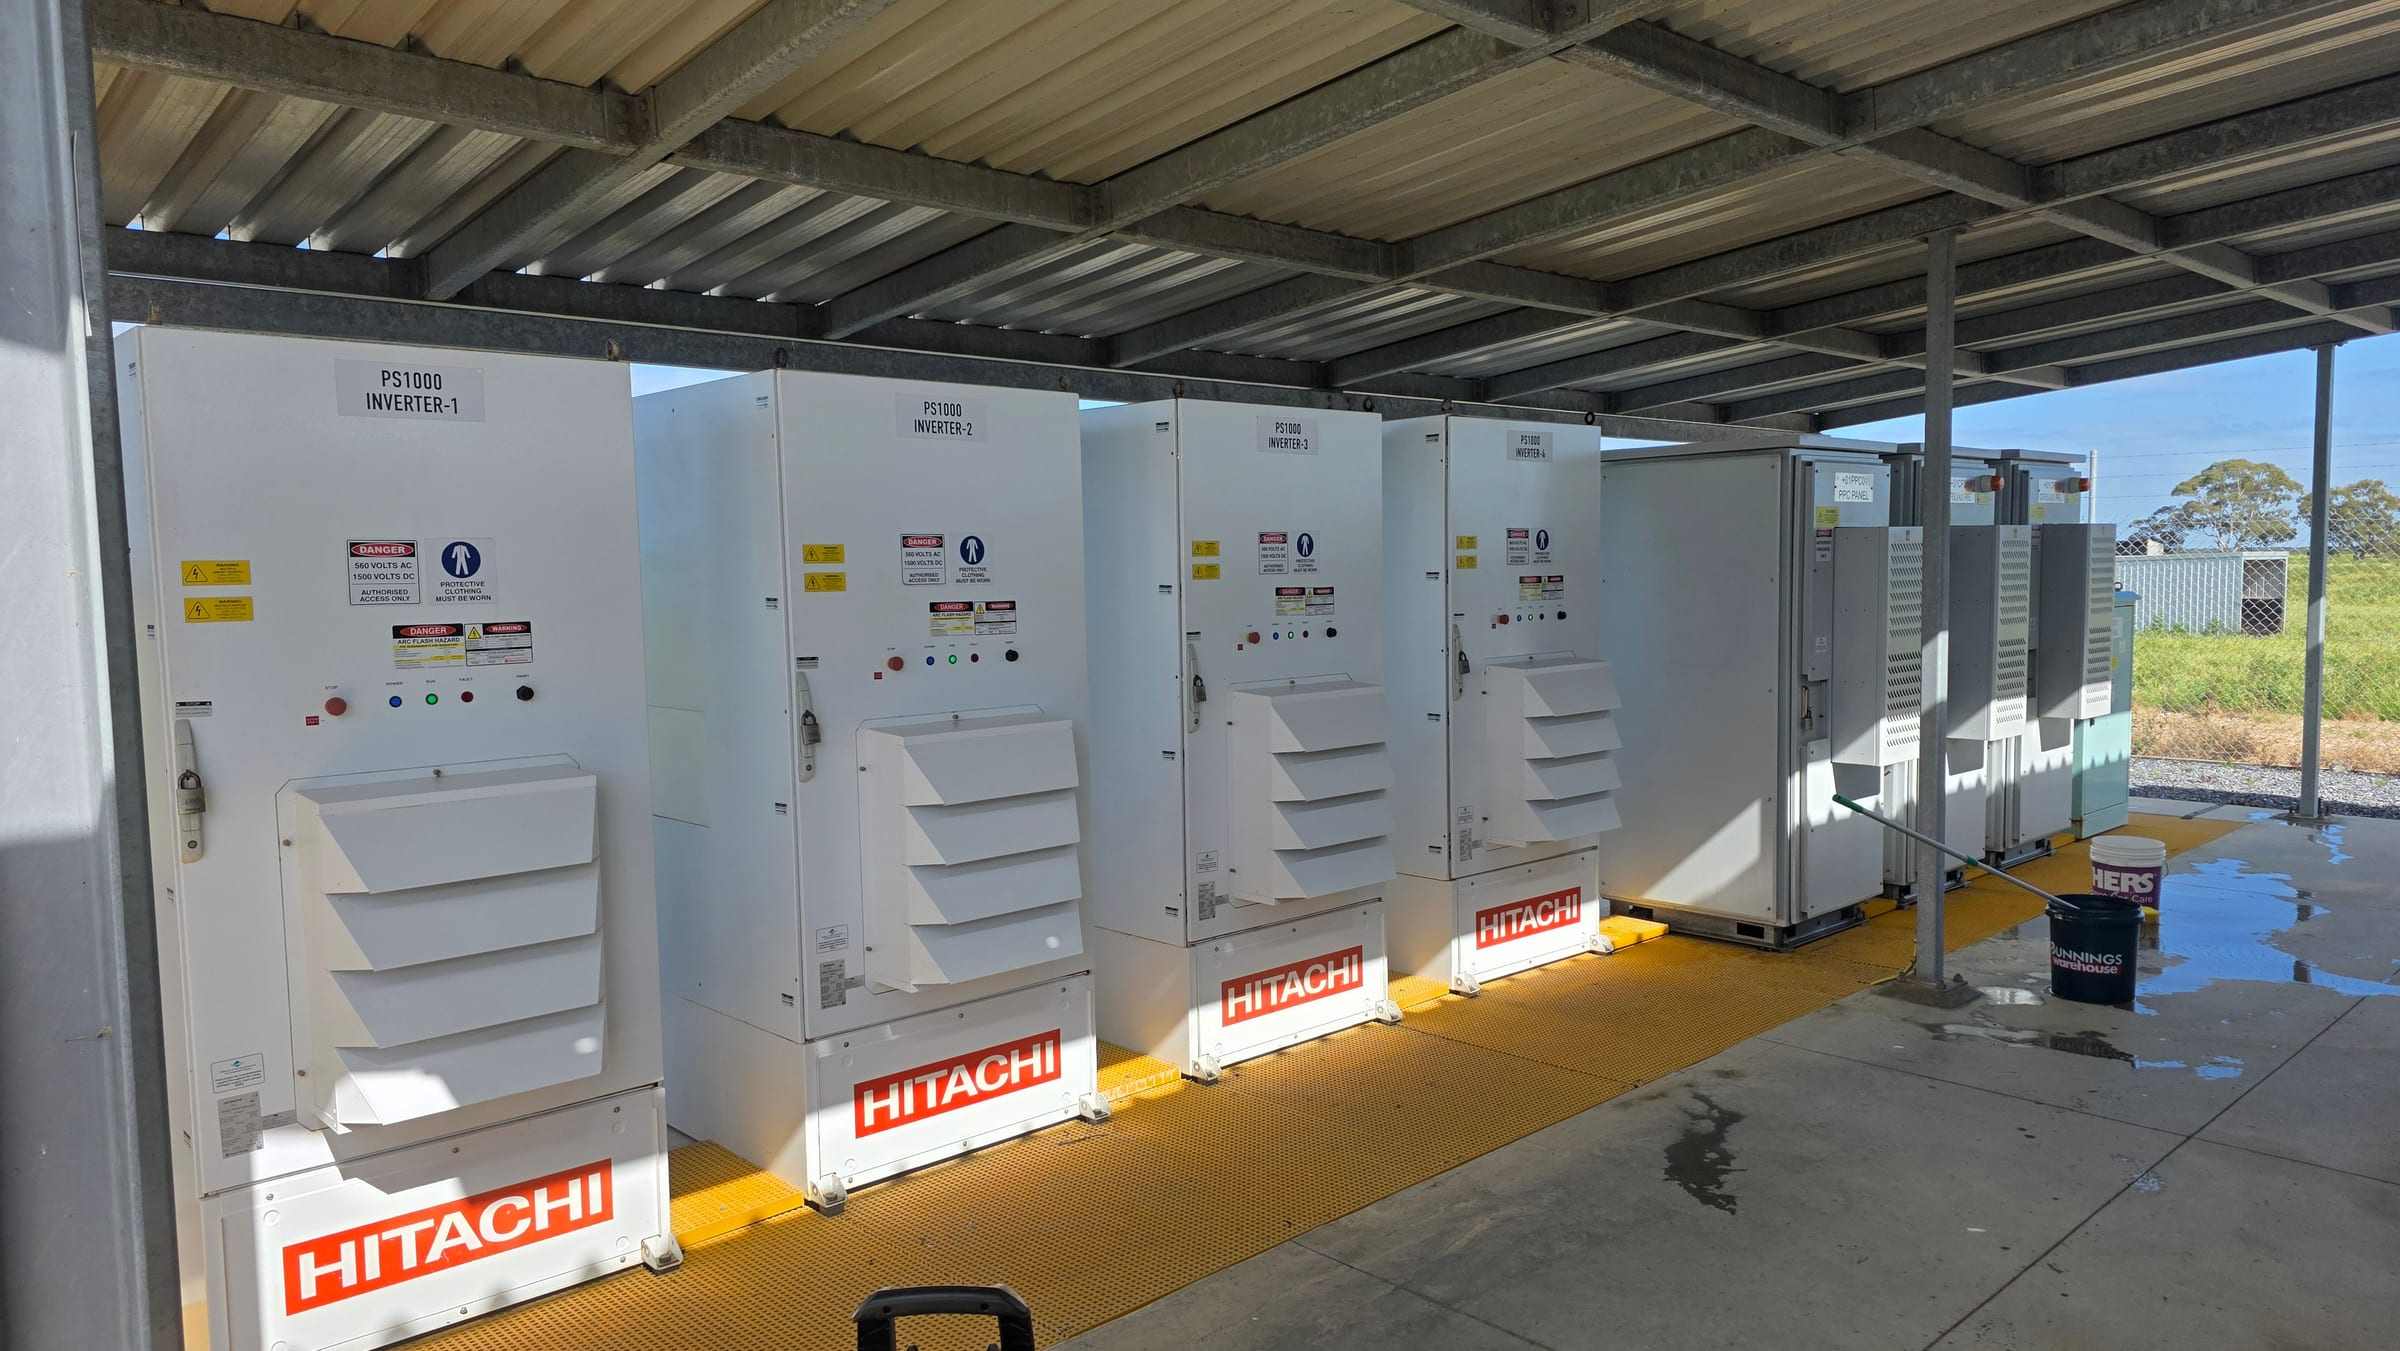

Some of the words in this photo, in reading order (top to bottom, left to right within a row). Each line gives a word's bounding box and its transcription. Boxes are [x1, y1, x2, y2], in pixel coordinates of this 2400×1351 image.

[381, 369, 442, 390] PS1000
[366, 392, 458, 414] INVERTER-1
[924, 401, 962, 417] PS1000
[914, 419, 973, 436] INVERTER-2
[1275, 422, 1302, 434] PS1000
[1268, 437, 1309, 450] INVERTER-3
[360, 543, 405, 554] DANGER
[400, 561, 412, 569] AC
[410, 626, 447, 636] DANGER
[1480, 893, 1578, 943] HITACHI
[2053, 958, 2118, 974] warehouse
[1227, 954, 1358, 1019] HITACHI
[863, 1039, 1055, 1128] HITACHI
[299, 1172, 603, 1300] HITACHI
